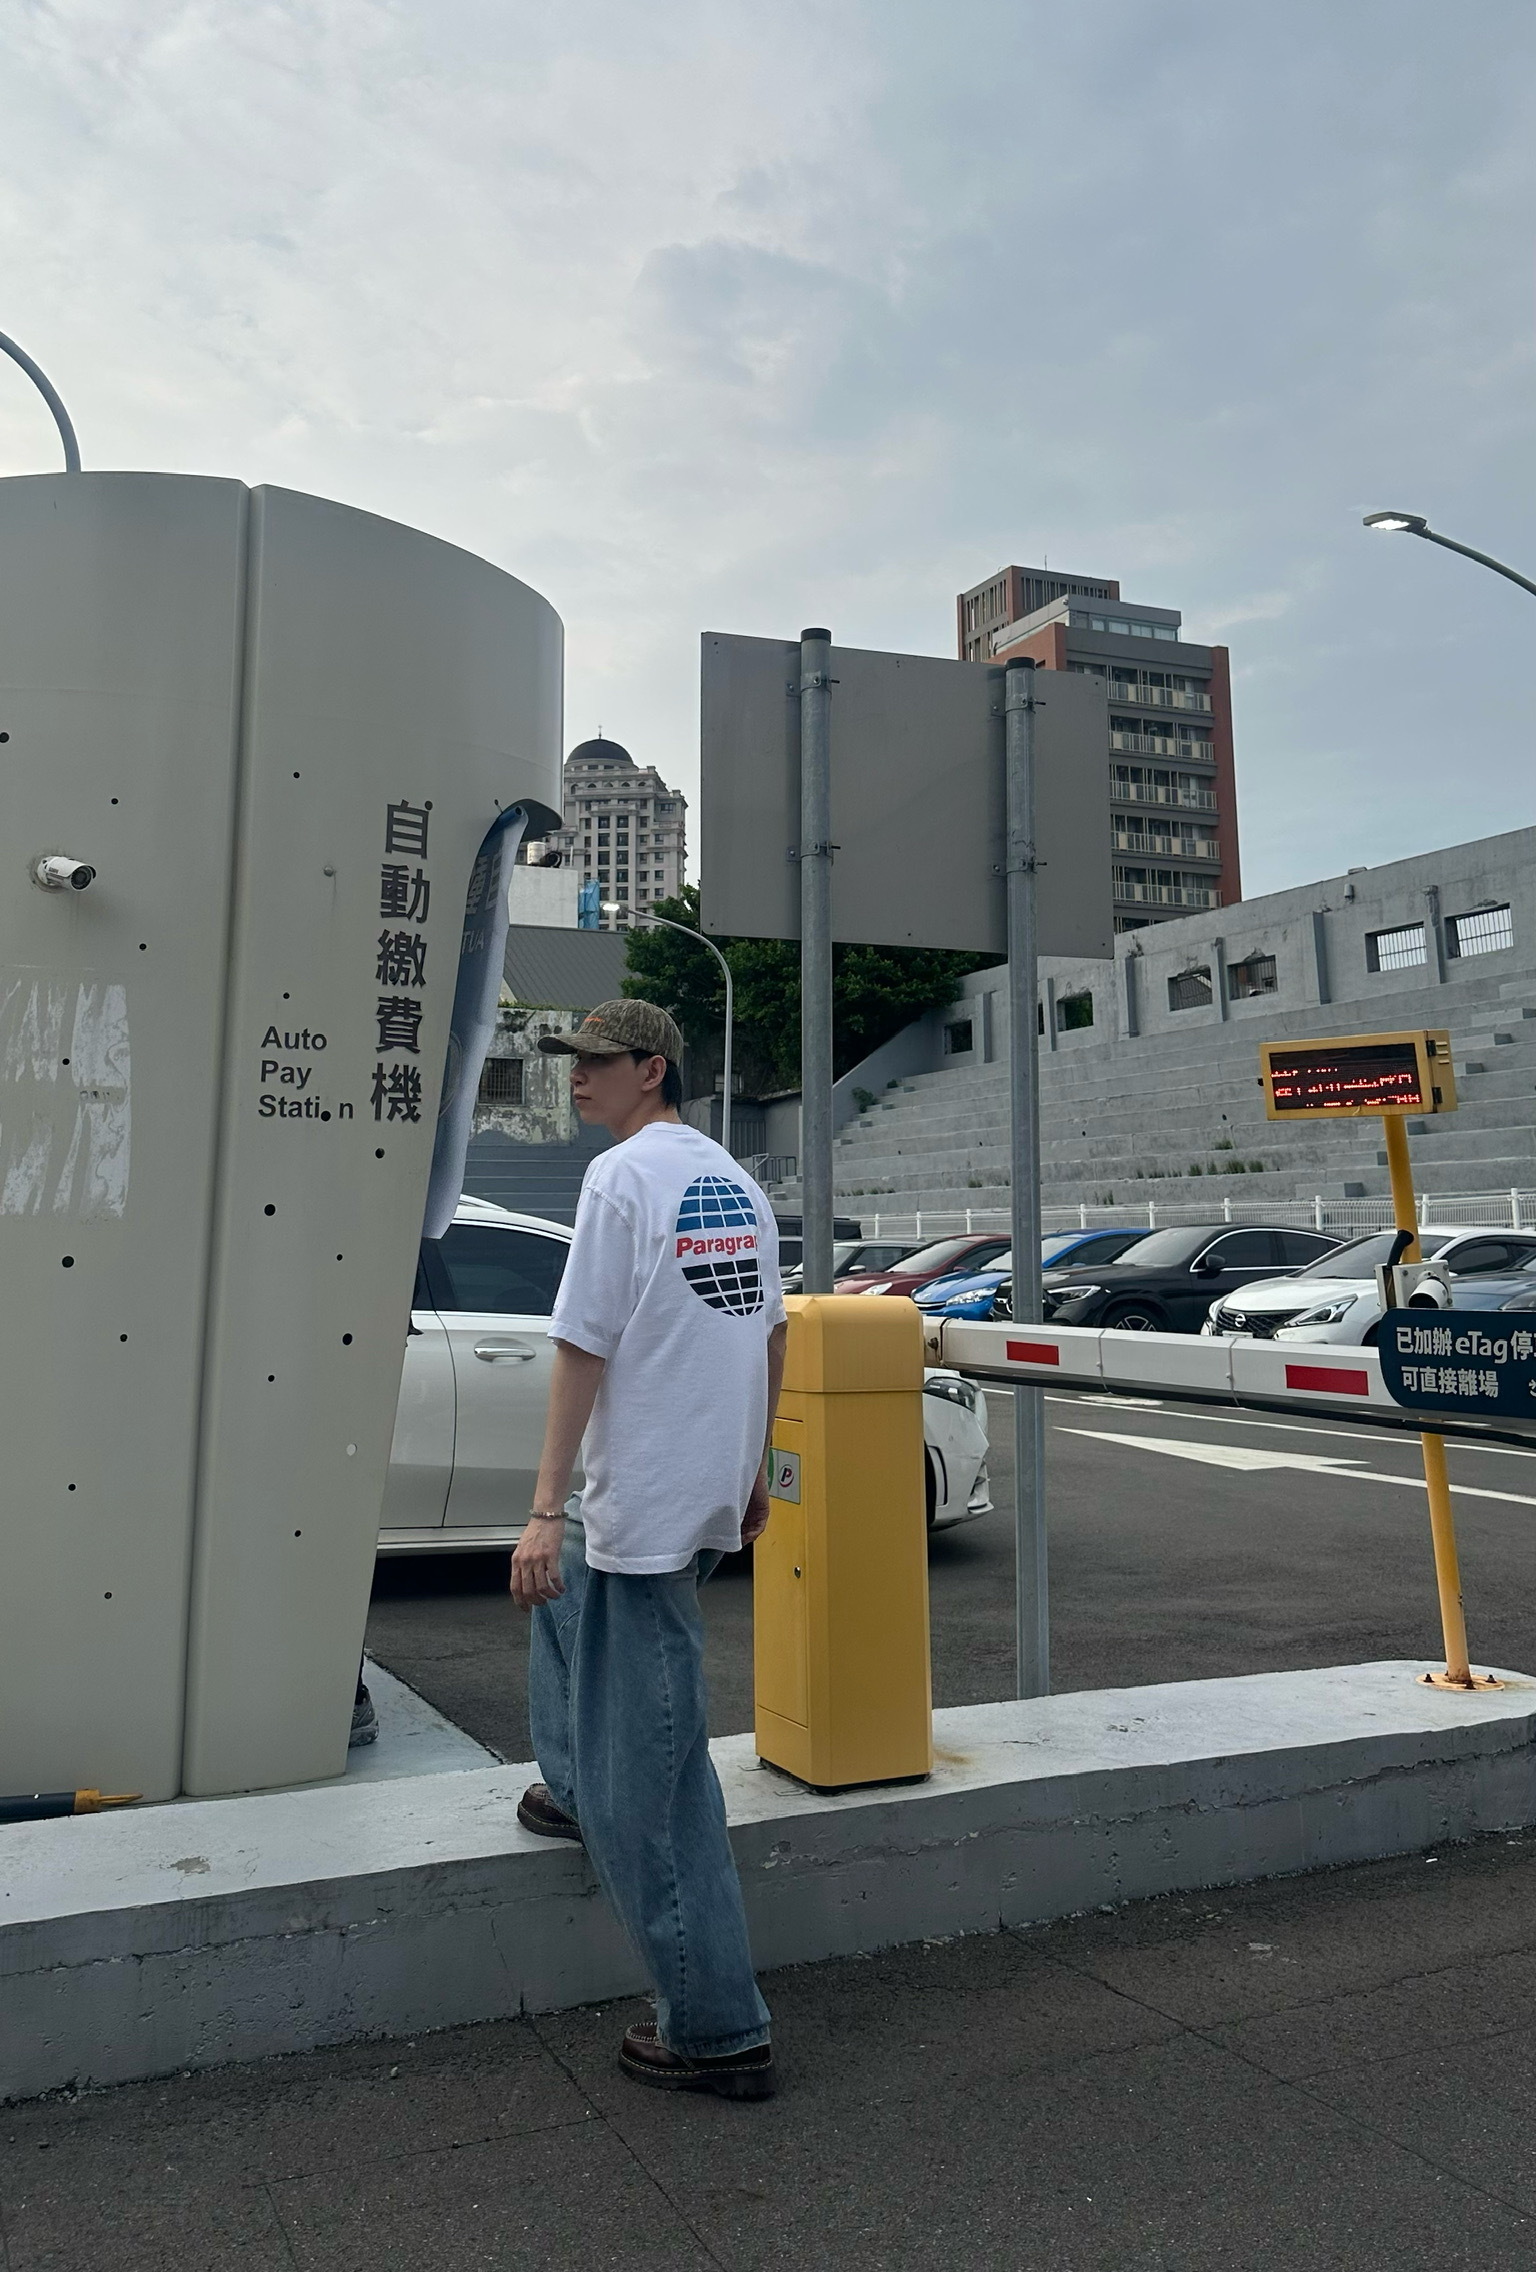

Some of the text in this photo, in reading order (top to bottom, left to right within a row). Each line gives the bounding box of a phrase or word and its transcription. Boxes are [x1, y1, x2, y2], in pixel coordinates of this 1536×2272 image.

[370, 799, 431, 1123] 自動繳費機
[260, 1025, 328, 1051] Auto
[260, 1059, 312, 1090] Pay
[258, 1094, 354, 1120] Statin
[1401, 1366, 1499, 1398] 可直接離場
